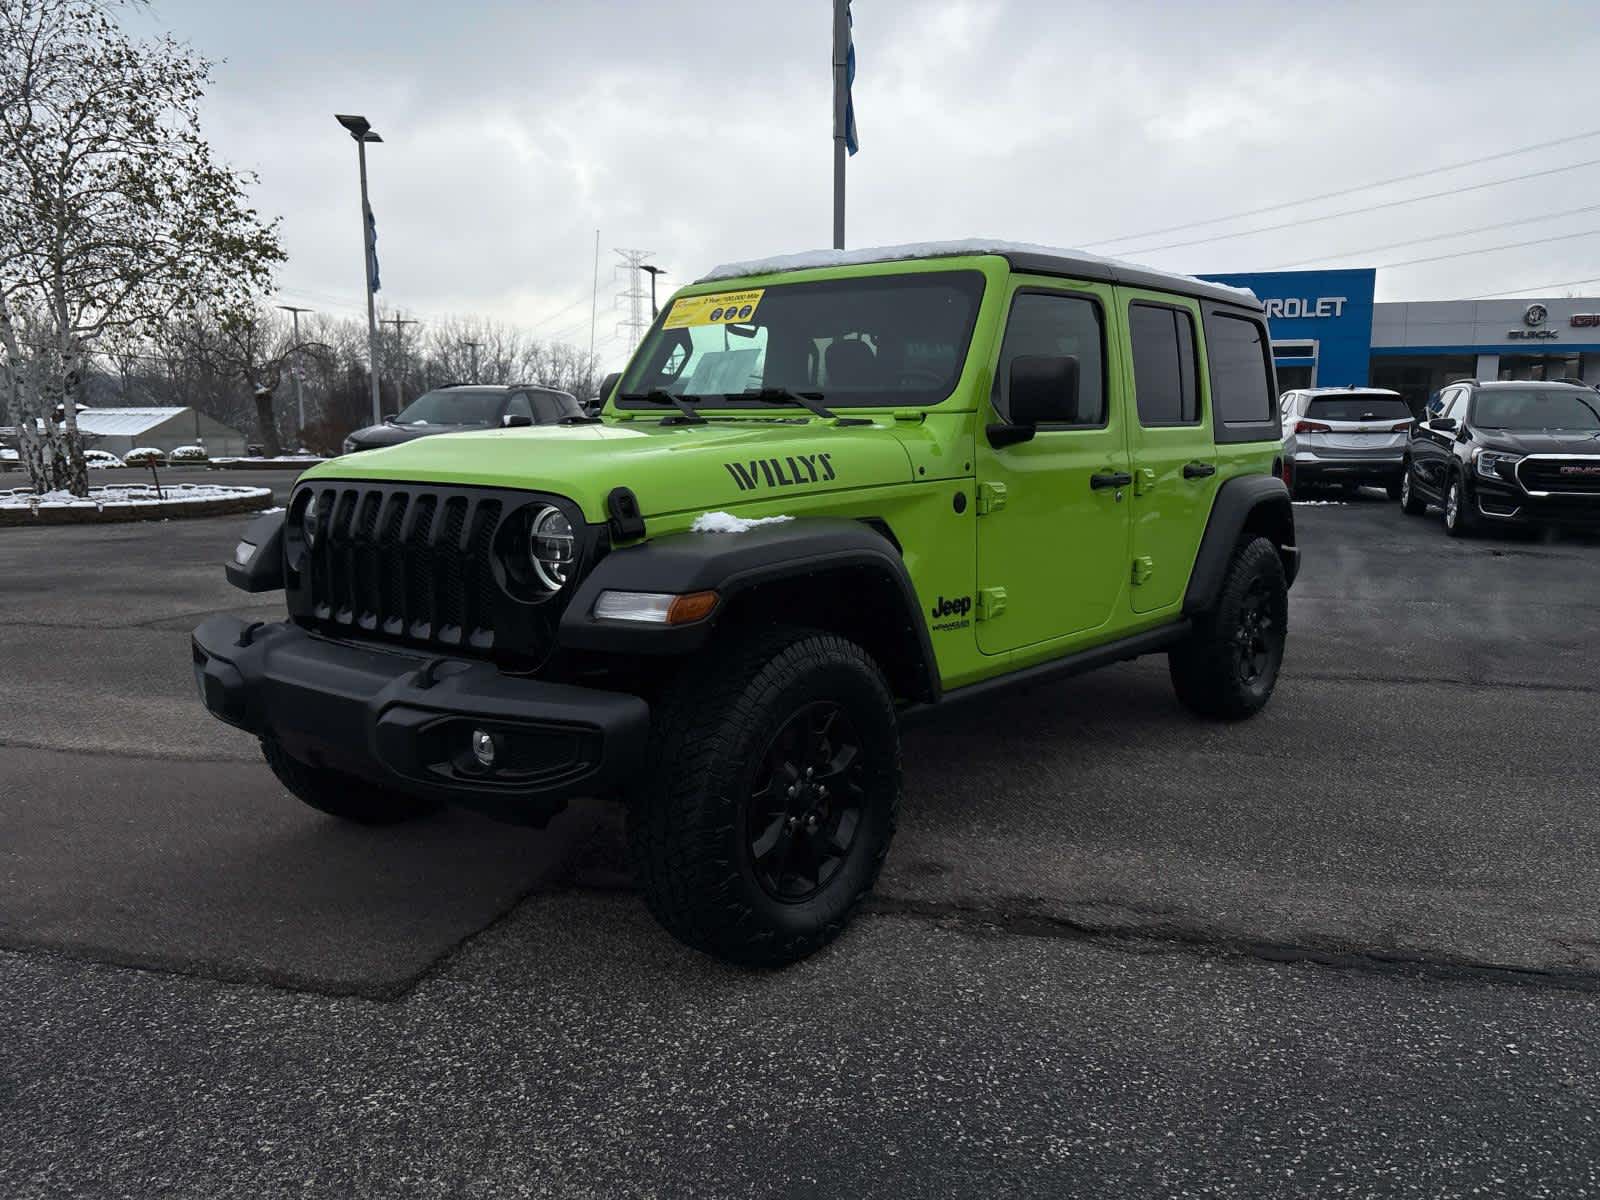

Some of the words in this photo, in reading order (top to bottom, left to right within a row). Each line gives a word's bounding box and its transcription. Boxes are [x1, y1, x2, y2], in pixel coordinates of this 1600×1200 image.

[1508, 329, 1559, 340] BUICK
[724, 453, 836, 491] WILLYS
[931, 596, 971, 618] Jeep
